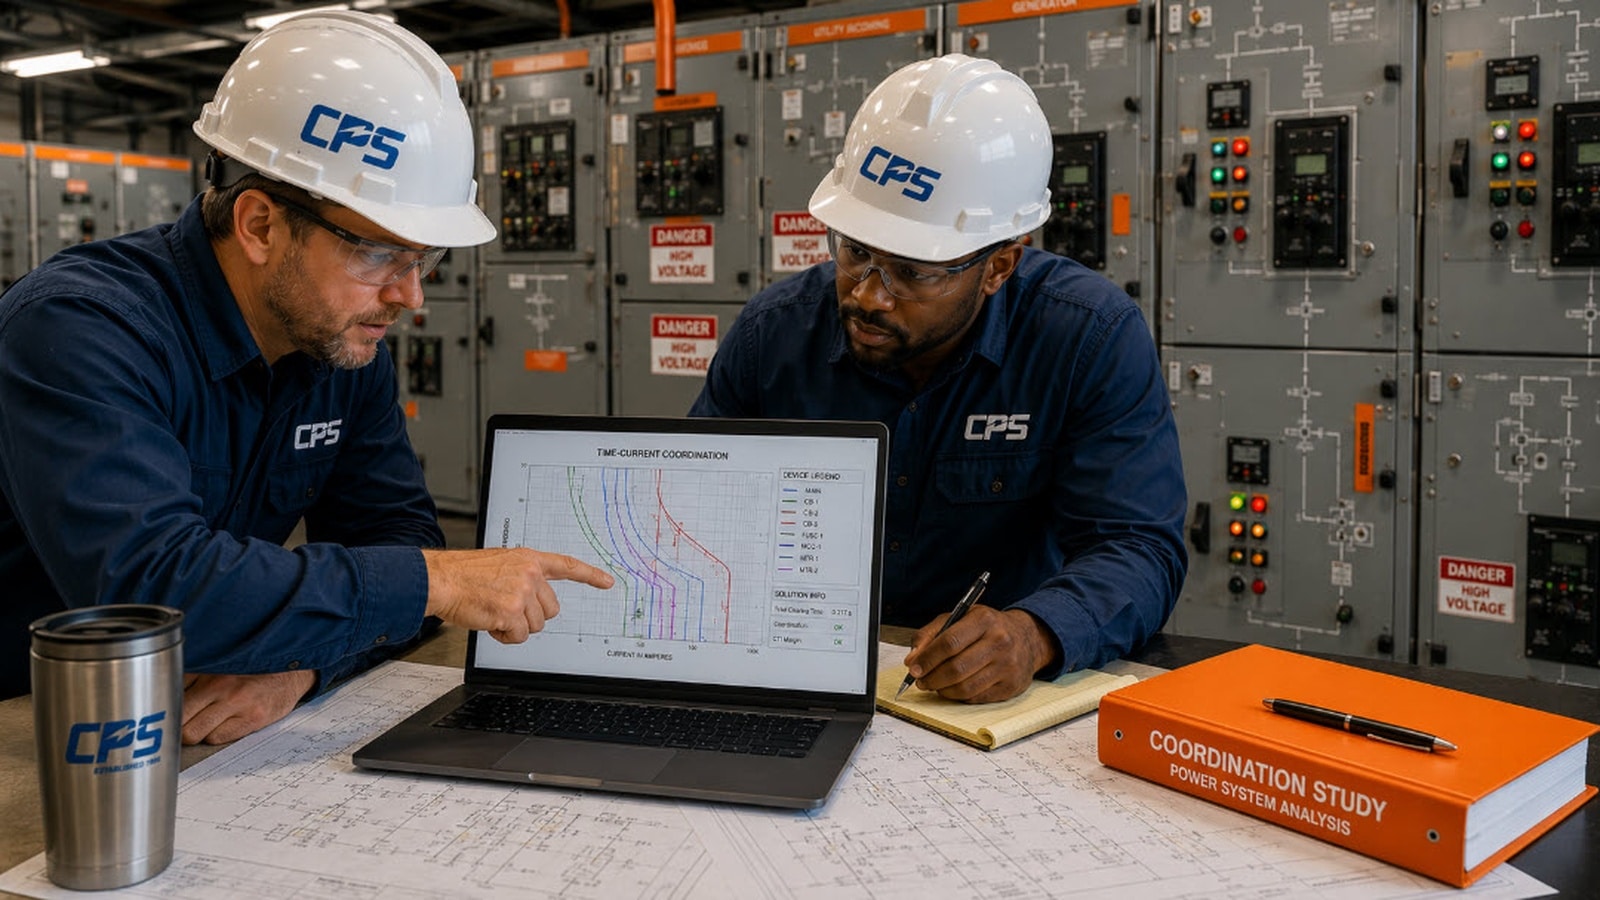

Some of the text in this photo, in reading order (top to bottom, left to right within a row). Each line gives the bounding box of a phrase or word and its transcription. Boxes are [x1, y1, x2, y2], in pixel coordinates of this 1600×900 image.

[300, 103, 407, 170] CPS
[860, 146, 942, 202] CPS
[779, 215, 826, 233] DANGE
[656, 227, 708, 245] DANGER
[792, 240, 819, 250] HIGH
[669, 250, 694, 262] HIGH
[657, 264, 708, 278] VOLTAGE
[657, 319, 710, 336] DANGER
[671, 341, 697, 354] HIGH
[658, 355, 709, 371] VOLTAGE
[294, 419, 343, 450] CPS
[964, 414, 1031, 441] CPS
[597, 448, 729, 461] TIME-CURRENT COORDINATION
[1448, 563, 1506, 581] DANGER
[1461, 585, 1490, 598] HIGH
[1447, 596, 1506, 615] VOLTAGE
[65, 710, 166, 764] CPS
[1150, 730, 1388, 823] COORDINATION STUDY
[1169, 763, 1352, 837] POWER SYSTEM ANALYSIS
